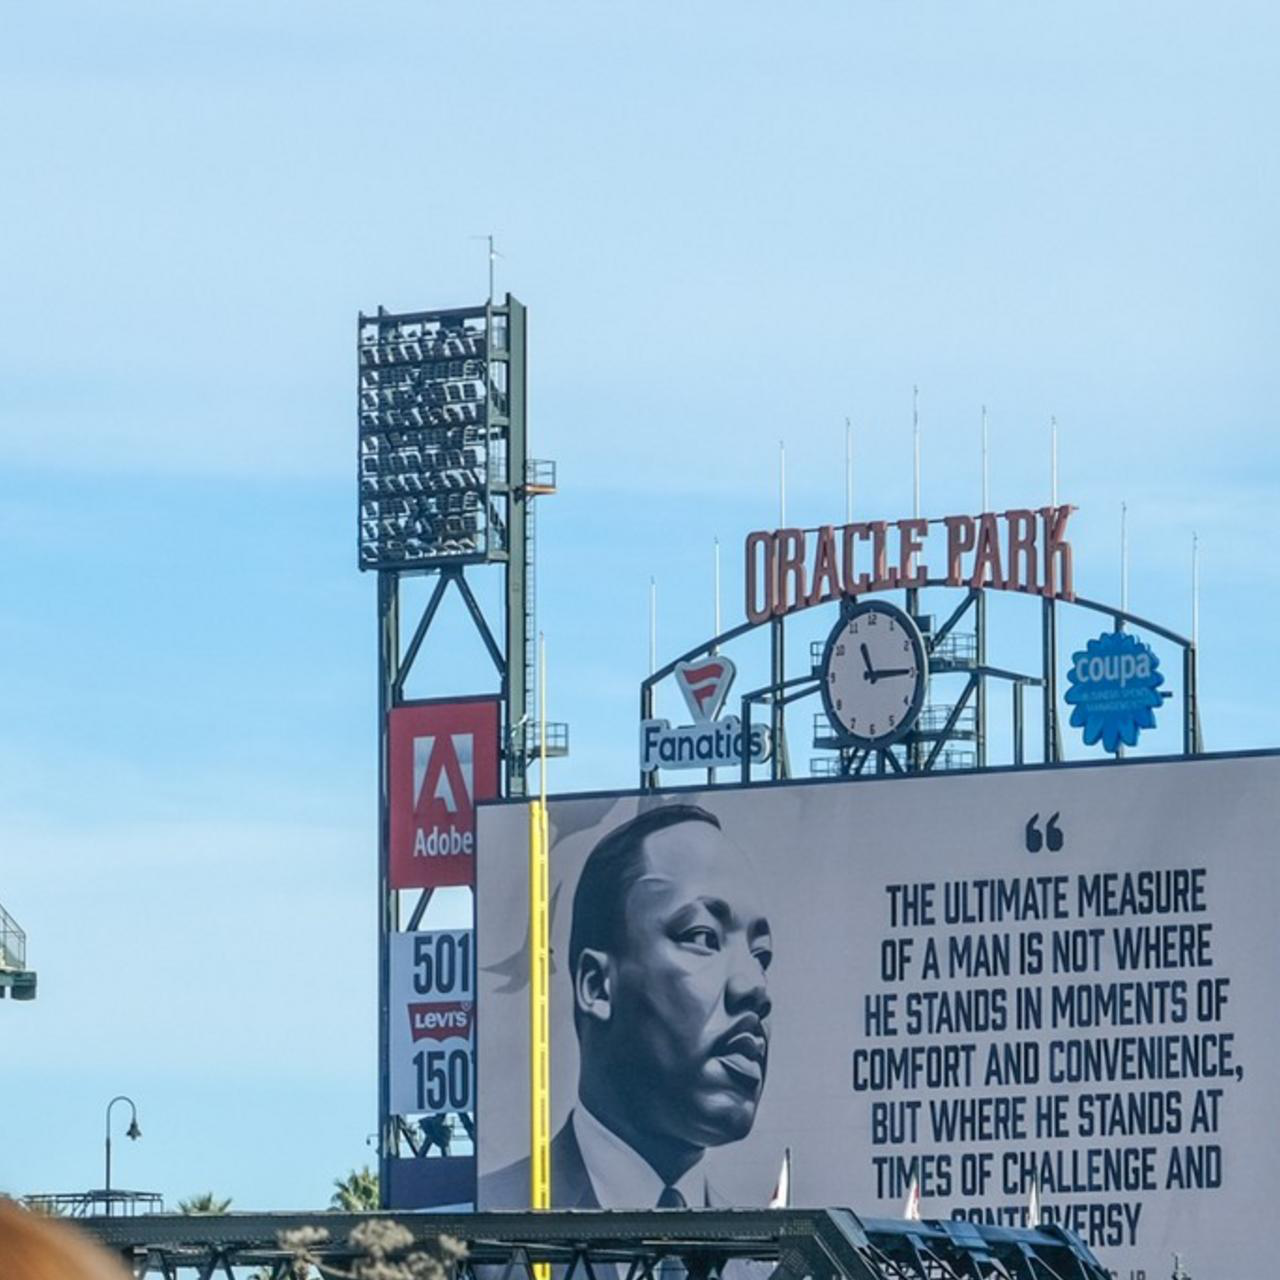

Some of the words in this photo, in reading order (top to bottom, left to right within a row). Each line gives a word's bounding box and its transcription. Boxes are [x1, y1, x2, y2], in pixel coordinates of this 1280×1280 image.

[745, 518, 928, 624] ORACLE
[945, 504, 1075, 602] PARK
[849, 622, 858, 634] 11
[868, 614, 877, 625] 12
[903, 640, 909, 652] 2
[1076, 653, 1151, 688] coupa
[644, 723, 763, 763] Fanatics
[413, 825, 474, 857] Adobe
[885, 882, 936, 928] THE
[944, 875, 1069, 925] ULTIMATE
[1077, 868, 1207, 918] MEASURE
[413, 933, 470, 995] 501
[881, 938, 914, 982] OF
[921, 937, 941, 981] A
[948, 933, 1010, 979] MAN
[1019, 931, 1043, 976] IS
[1052, 928, 1106, 974] NOT
[1112, 923, 1213, 971] WHERE
[865, 993, 898, 1037] HE
[906, 988, 1007, 1036] STANDS
[1016, 986, 1042, 1031] IN
[1051, 980, 1188, 1029] MOMENTS
[1197, 977, 1231, 1022] OF
[852, 1043, 977, 1092] COMFORT
[984, 1041, 1040, 1087] AND
[1049, 1033, 1244, 1084] CONVENIENCE,
[872, 1100, 922, 1145] BUT
[929, 1096, 1027, 1143] WHERE
[1036, 1094, 1070, 1139] HE
[1078, 1090, 1182, 1138] STANDS
[1190, 1088, 1224, 1134] AT
[871, 1154, 952, 1200] TIMES
[961, 1152, 994, 1196] OF
[1002, 1147, 1157, 1195] CHALLENGE
[1165, 1144, 1222, 1190] AND
